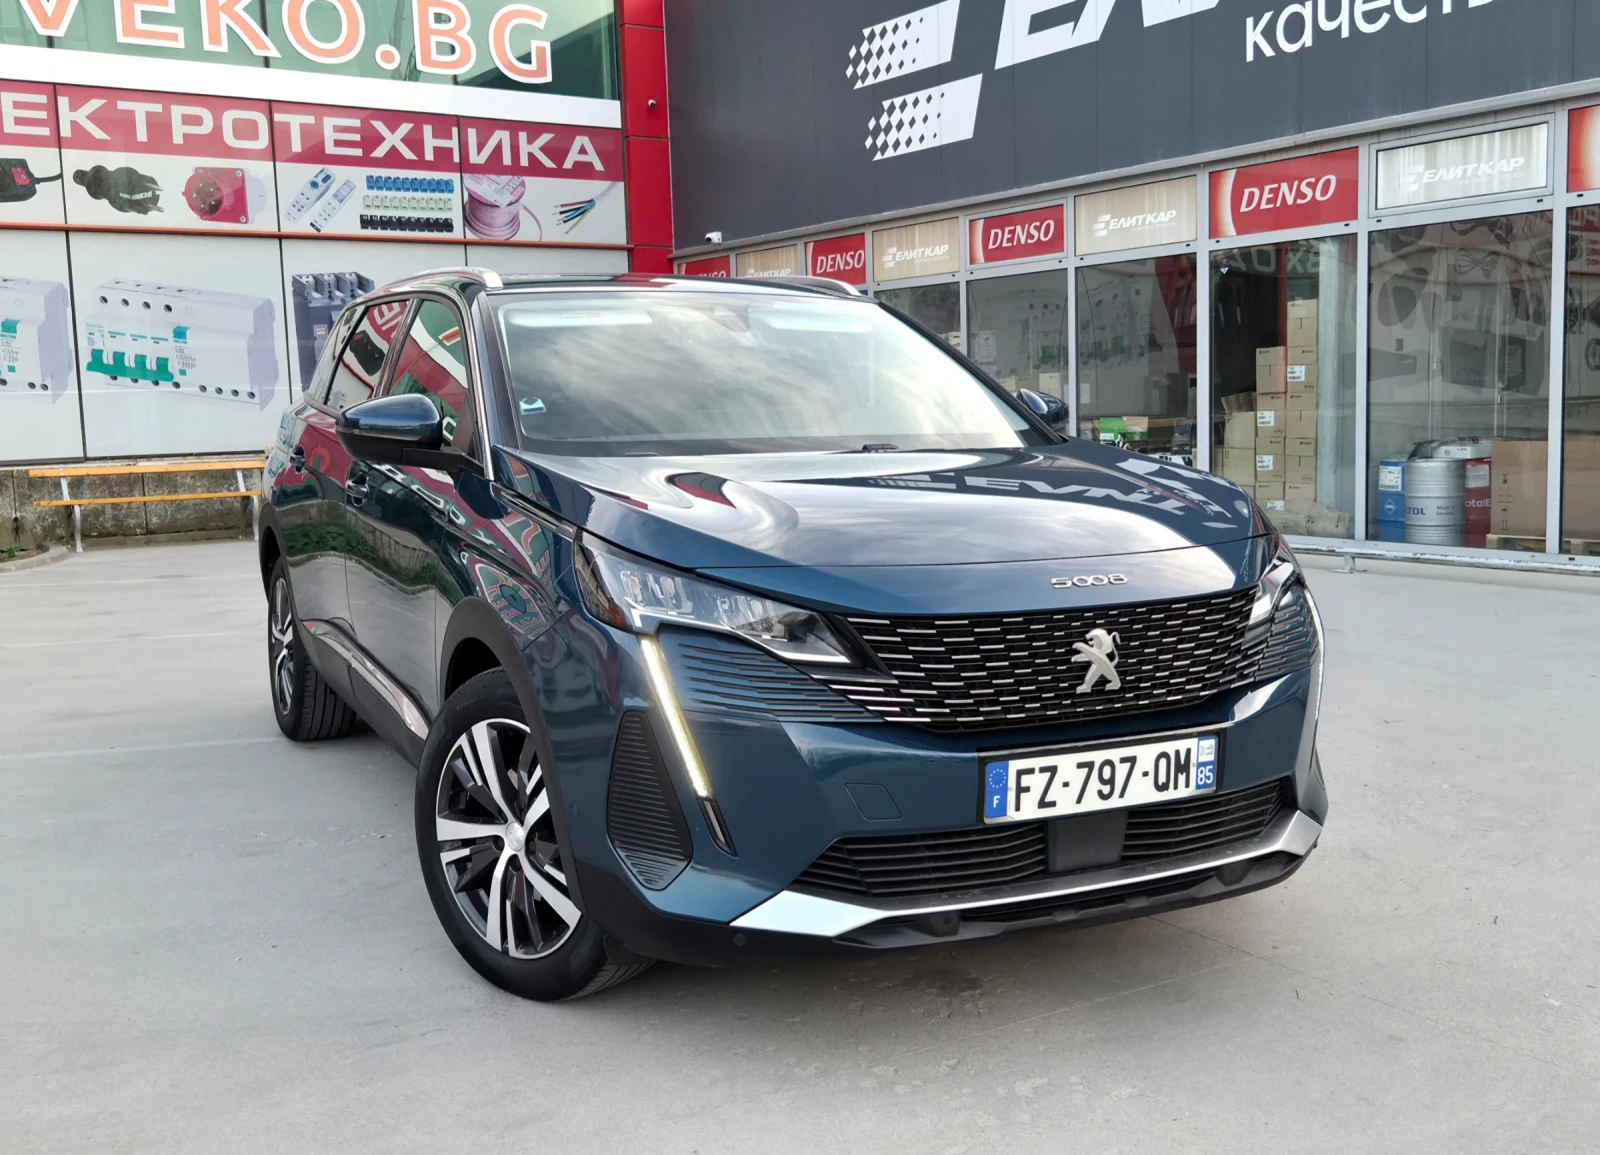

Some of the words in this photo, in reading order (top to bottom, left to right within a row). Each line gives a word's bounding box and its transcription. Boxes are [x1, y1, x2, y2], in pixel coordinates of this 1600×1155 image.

[0, 91, 605, 172] ЕКТРОТЕХНИКА
[1239, 174, 1337, 213] DENSO
[988, 219, 1055, 250] DENSO
[816, 249, 865, 274] DENSO
[1051, 573, 1128, 589] 5008
[1014, 747, 1191, 812] FZ-797-QM
[1197, 765, 1213, 786] 85
[993, 795, 1001, 808] F
